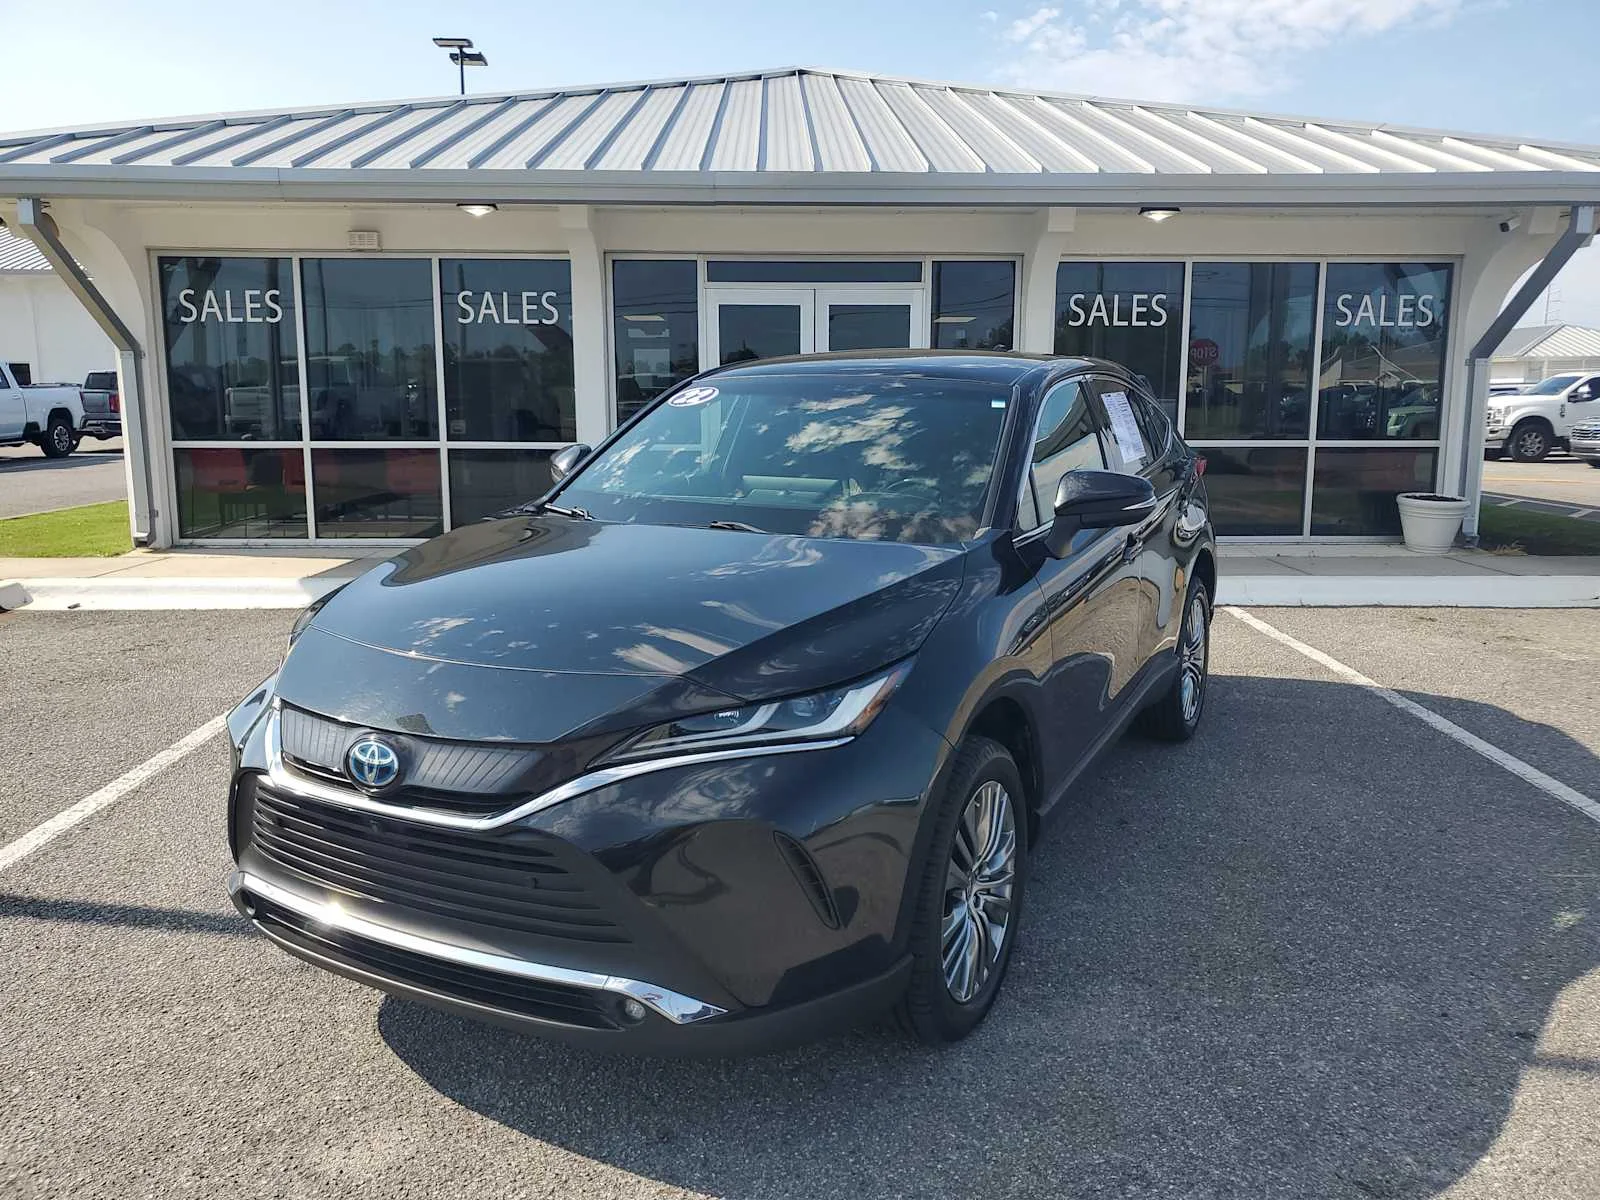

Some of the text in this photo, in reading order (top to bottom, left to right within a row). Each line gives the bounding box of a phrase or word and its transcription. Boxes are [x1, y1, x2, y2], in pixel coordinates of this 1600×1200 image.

[179, 289, 283, 323] SALES
[457, 290, 559, 325] SALES
[1068, 293, 1167, 327] SALES
[1335, 294, 1434, 327] SALES
